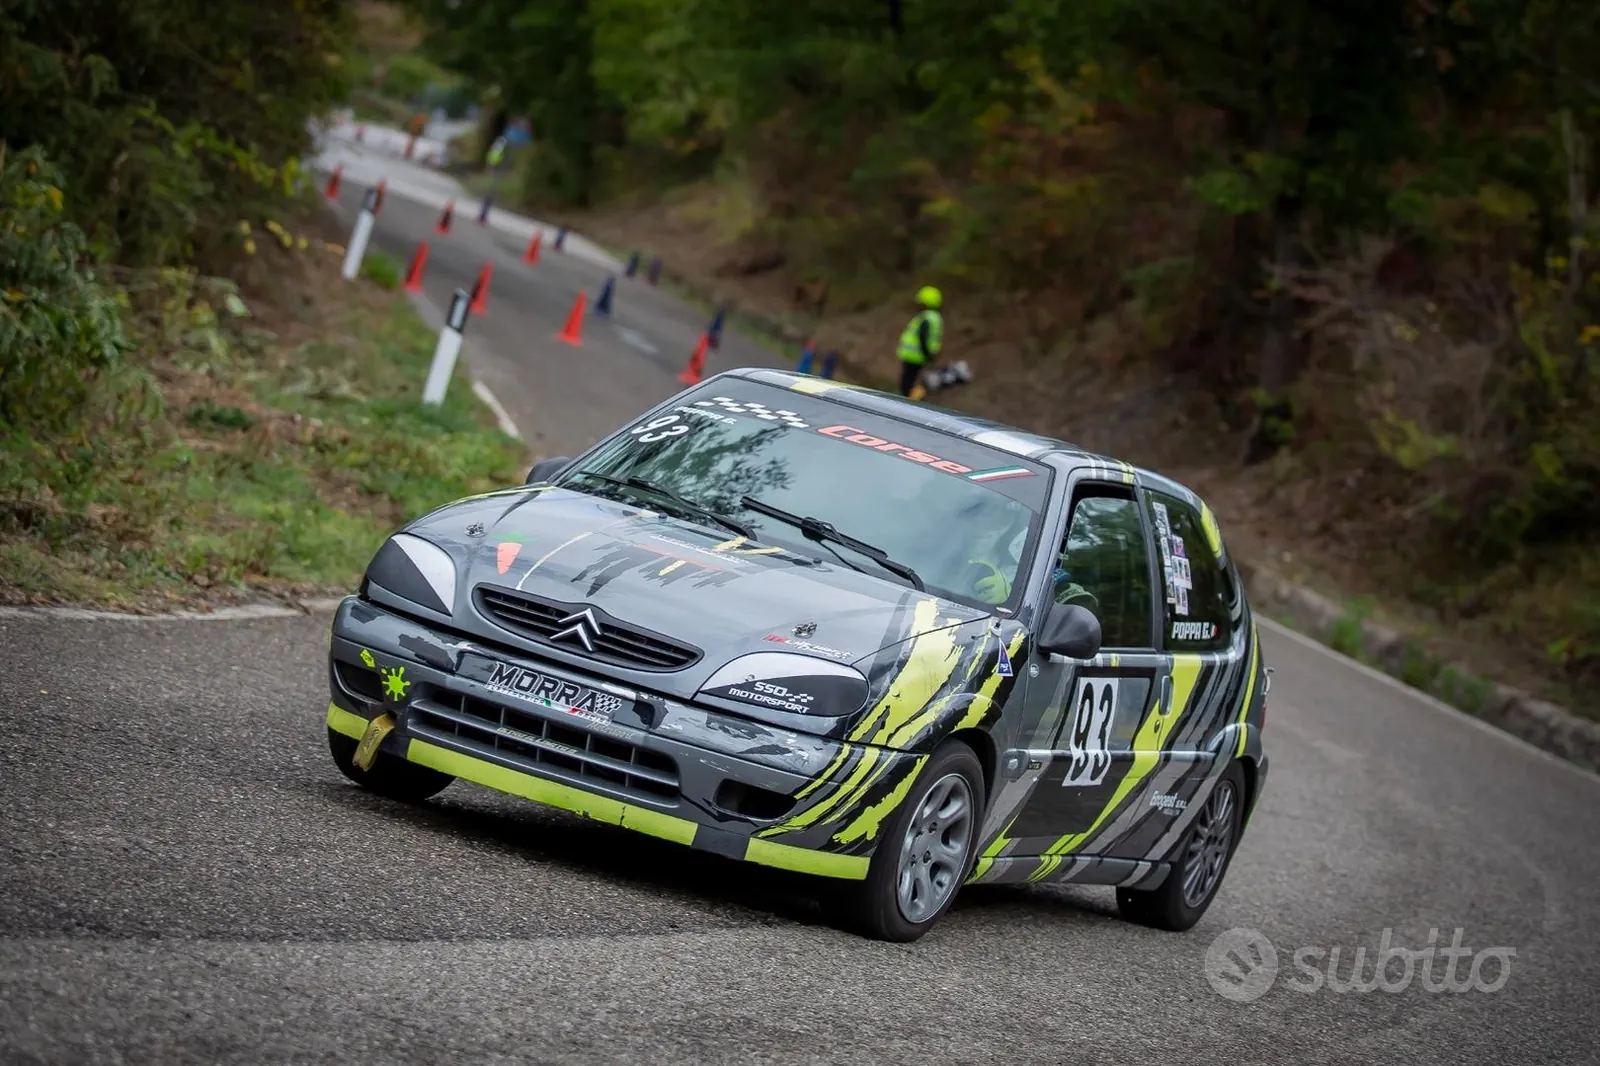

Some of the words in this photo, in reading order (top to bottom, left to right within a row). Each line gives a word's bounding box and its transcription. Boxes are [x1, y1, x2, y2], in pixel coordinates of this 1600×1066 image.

[631, 414, 690, 443] 93
[815, 424, 974, 474] Corse
[1171, 621, 1202, 640] POPPA
[486, 661, 598, 713] MORRA
[728, 687, 810, 714] MOTORSPORT
[1070, 682, 1114, 782] 93
